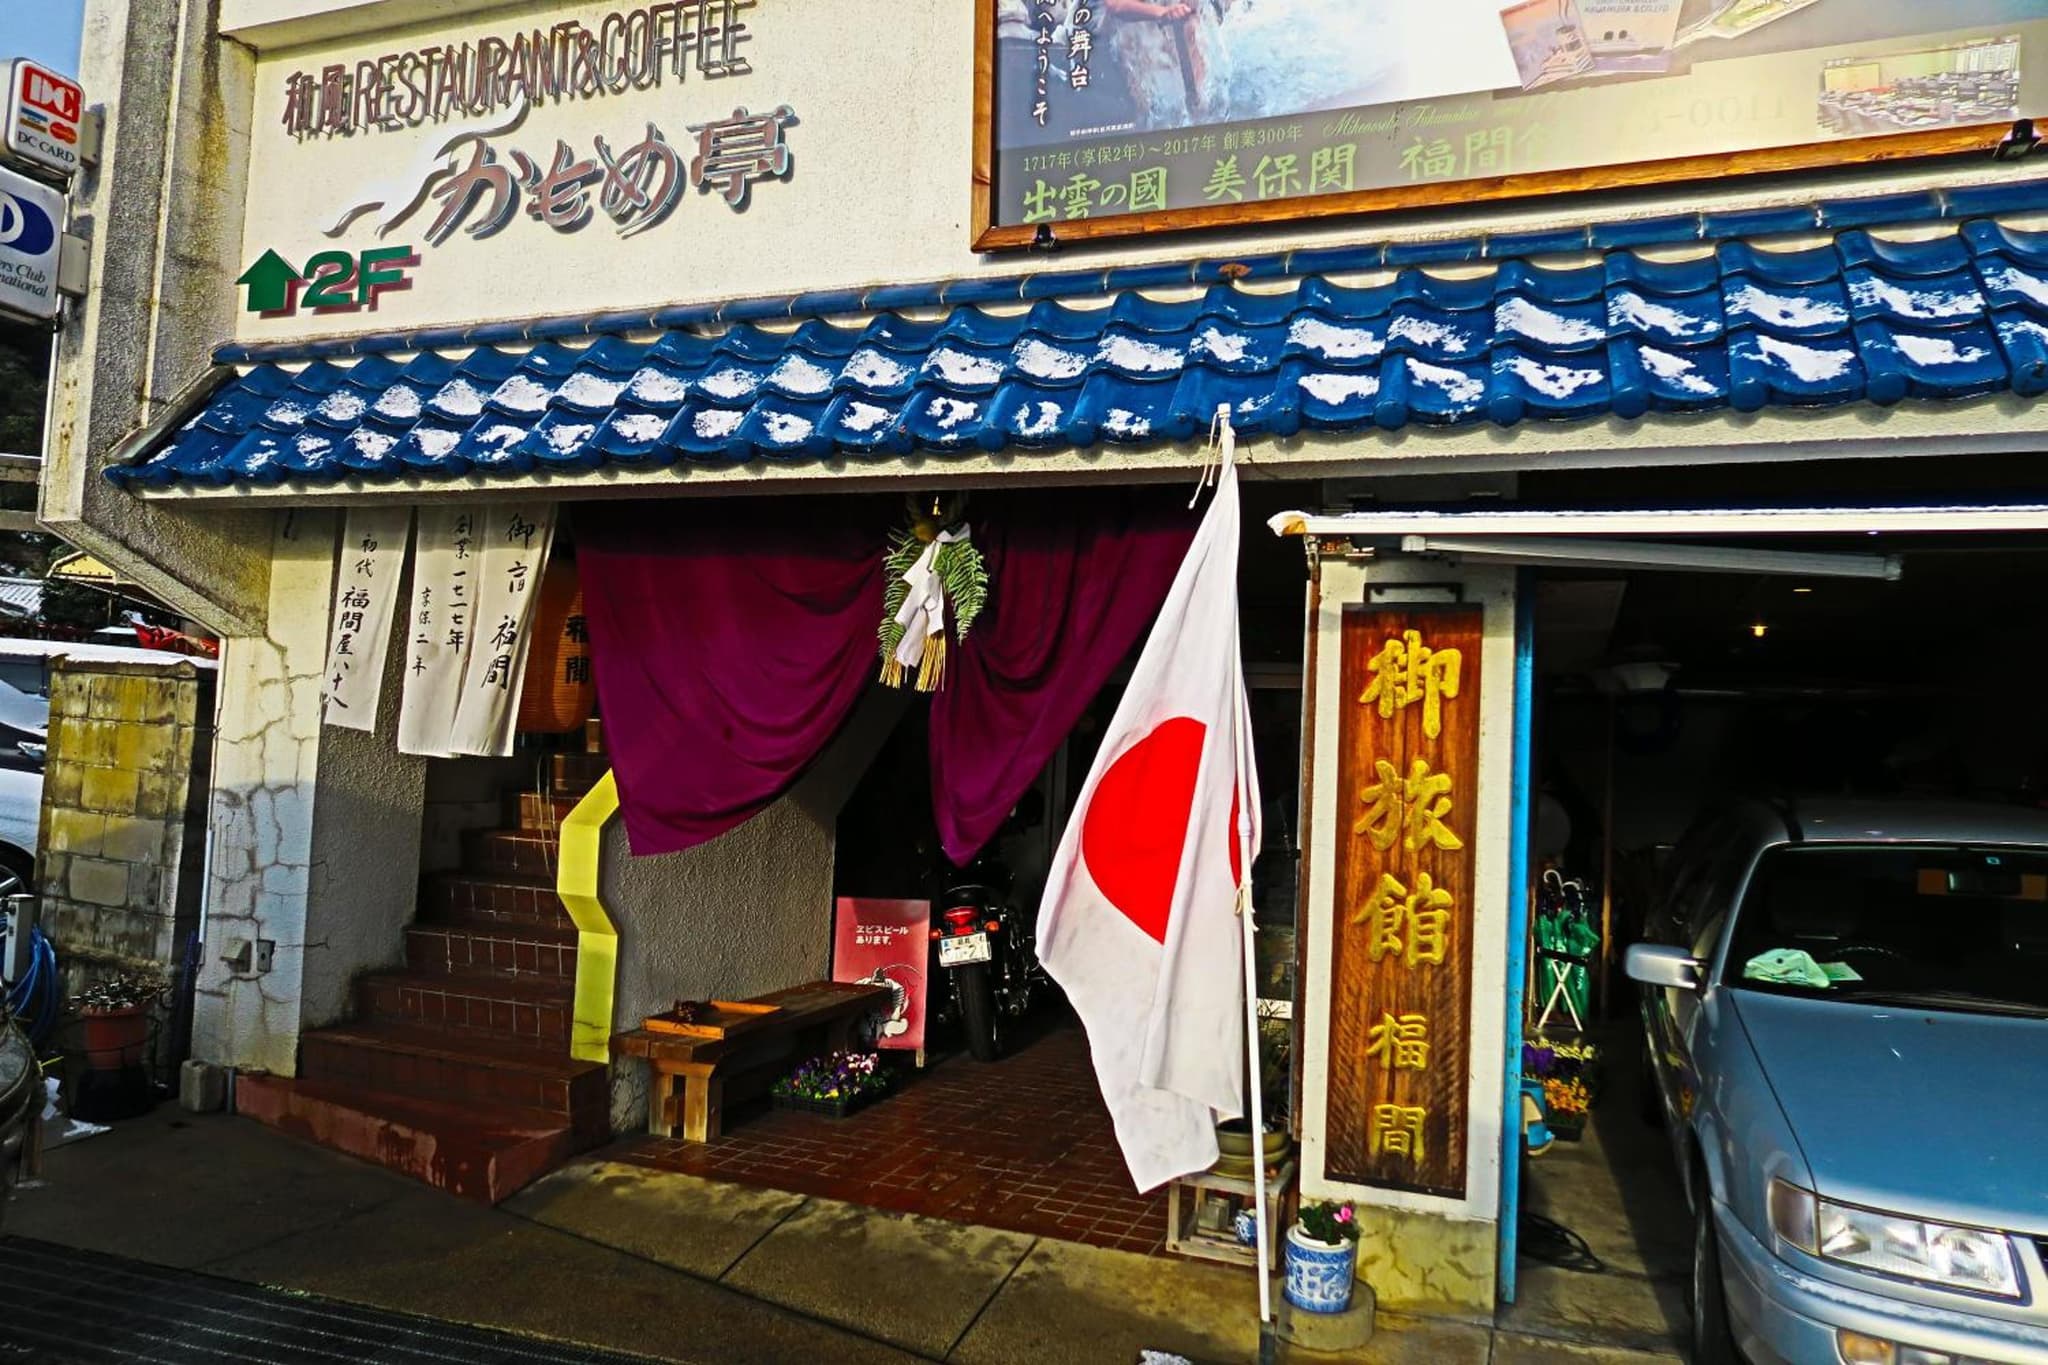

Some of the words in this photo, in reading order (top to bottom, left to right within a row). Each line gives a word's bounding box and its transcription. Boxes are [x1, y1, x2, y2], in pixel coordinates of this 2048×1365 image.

[1032, 0, 1054, 126] へようこそ
[1067, 0, 1093, 90] の舞台
[30, 73, 75, 118] DC
[39, 141, 75, 163] CARD
[1223, 123, 1304, 150] 創業300年
[424, 103, 796, 242] かもめ亭
[1022, 166, 1168, 224] 出雲の國
[1202, 143, 1357, 201] 美保関
[1400, 122, 1554, 181] 福間
[16, 265, 46, 282] Club
[301, 245, 413, 308] 2F
